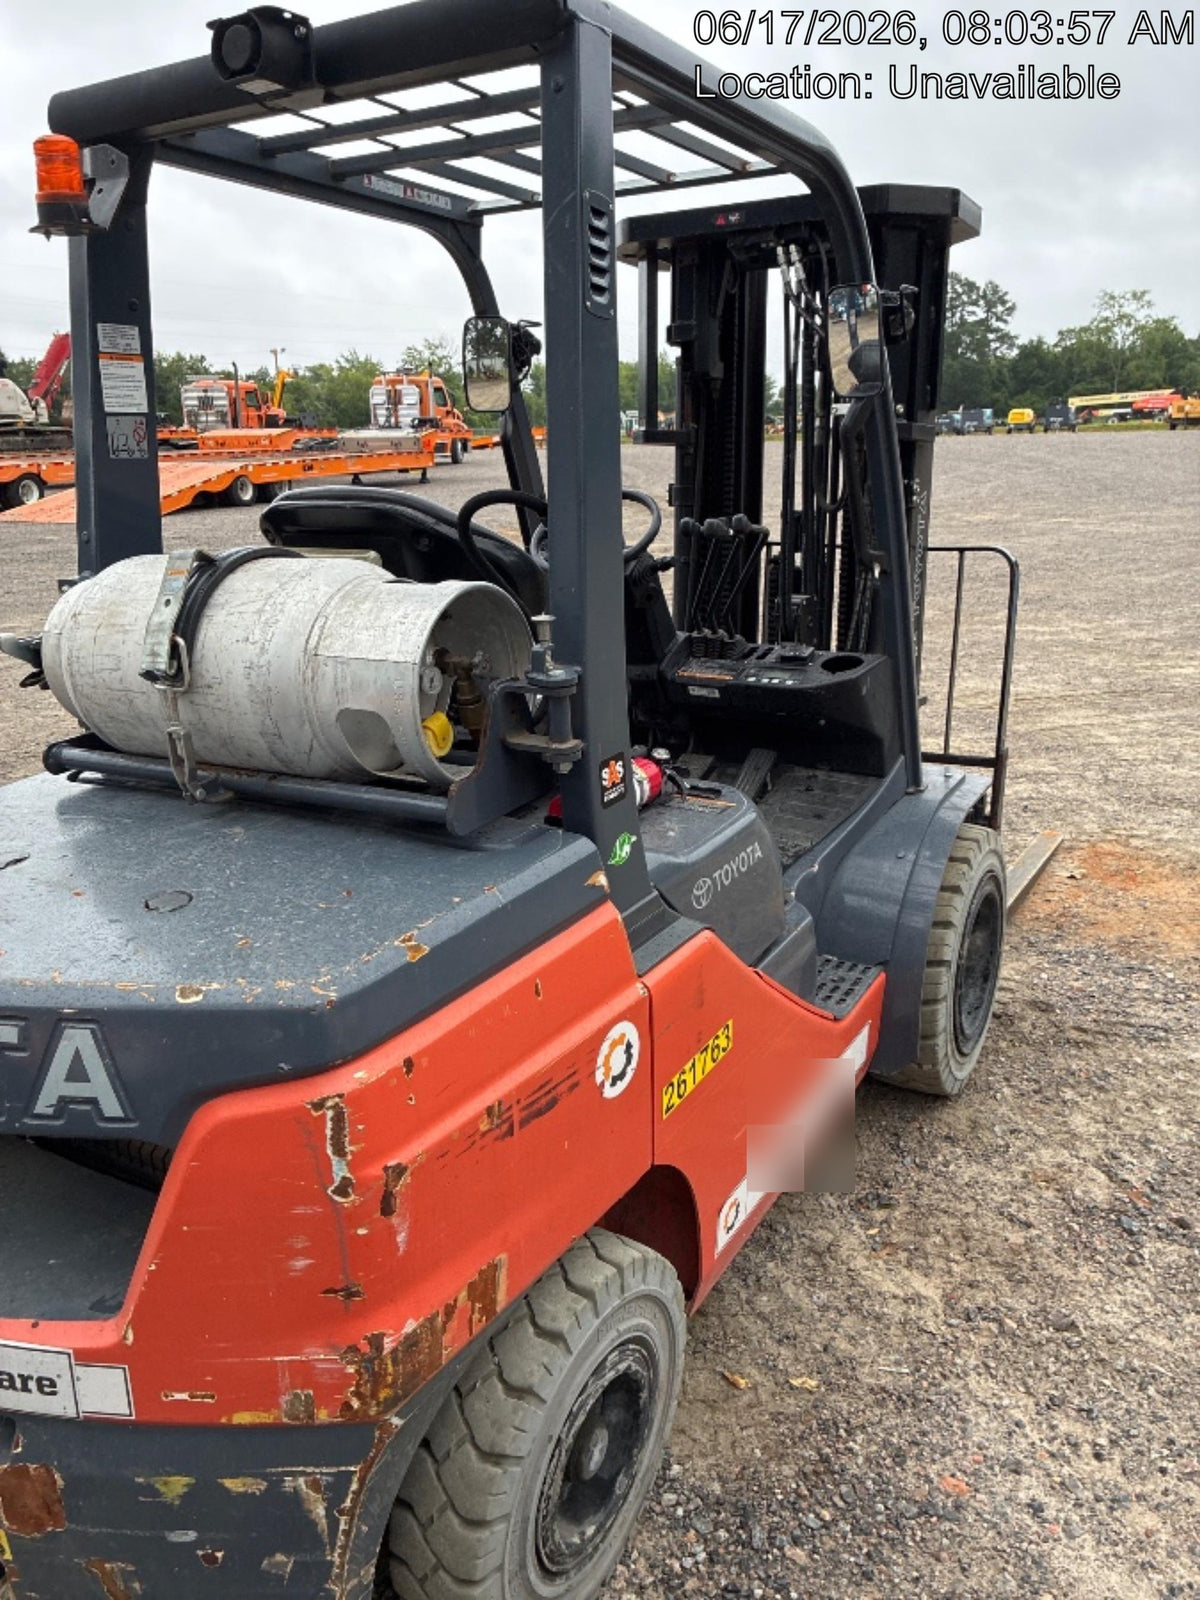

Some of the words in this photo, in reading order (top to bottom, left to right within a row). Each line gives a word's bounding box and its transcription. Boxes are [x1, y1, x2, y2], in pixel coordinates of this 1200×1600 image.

[713, 841, 763, 891] TOYOTA
[0, 1022, 130, 1120] A
[664, 1023, 731, 1115] 261763
